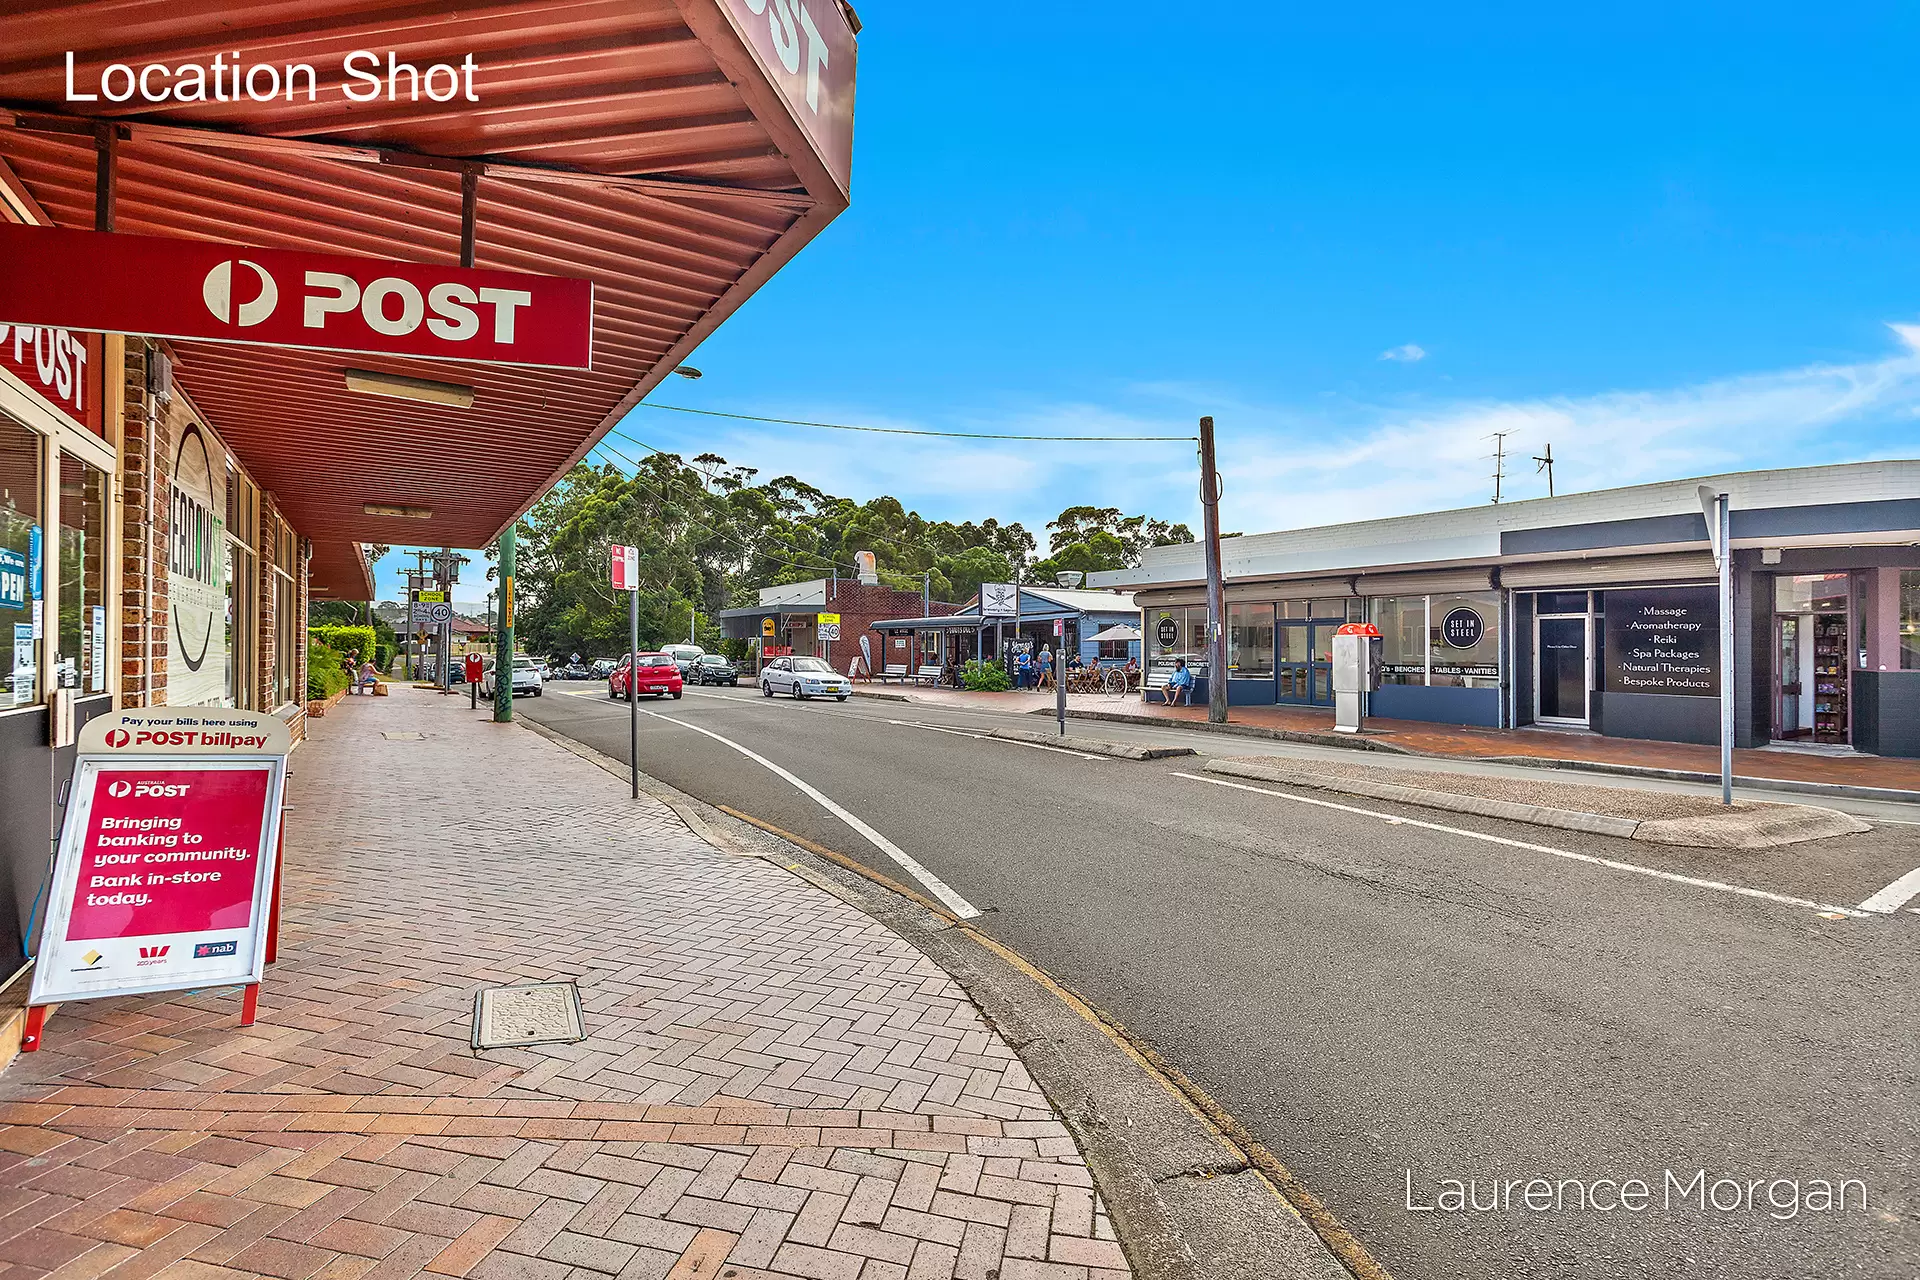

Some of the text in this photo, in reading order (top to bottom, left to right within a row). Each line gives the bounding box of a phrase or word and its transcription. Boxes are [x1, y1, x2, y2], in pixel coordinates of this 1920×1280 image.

[304, 271, 531, 345] POST
[1, 571, 24, 602] PEN
[434, 609, 448, 617] 40
[1644, 606, 1687, 617] Massage
[1450, 620, 1475, 628] SET IN
[1630, 621, 1701, 631] Aromatherapy
[1450, 629, 1475, 637] STEEL
[1654, 635, 1677, 644] Reiki
[1633, 648, 1700, 660] Spa Packages
[1623, 662, 1711, 674] Natural Therapies
[1624, 676, 1710, 688] Bespoke Products
[122, 717, 258, 728] Pay your bills here using
[136, 731, 268, 749] POST billpay
[134, 785, 190, 798] POST
[101, 816, 182, 831] Bringing
[98, 833, 202, 848] banking to
[94, 847, 251, 868] your community.
[90, 871, 222, 888] Bank in-store
[86, 892, 153, 907] today.
[211, 942, 234, 954] nab
